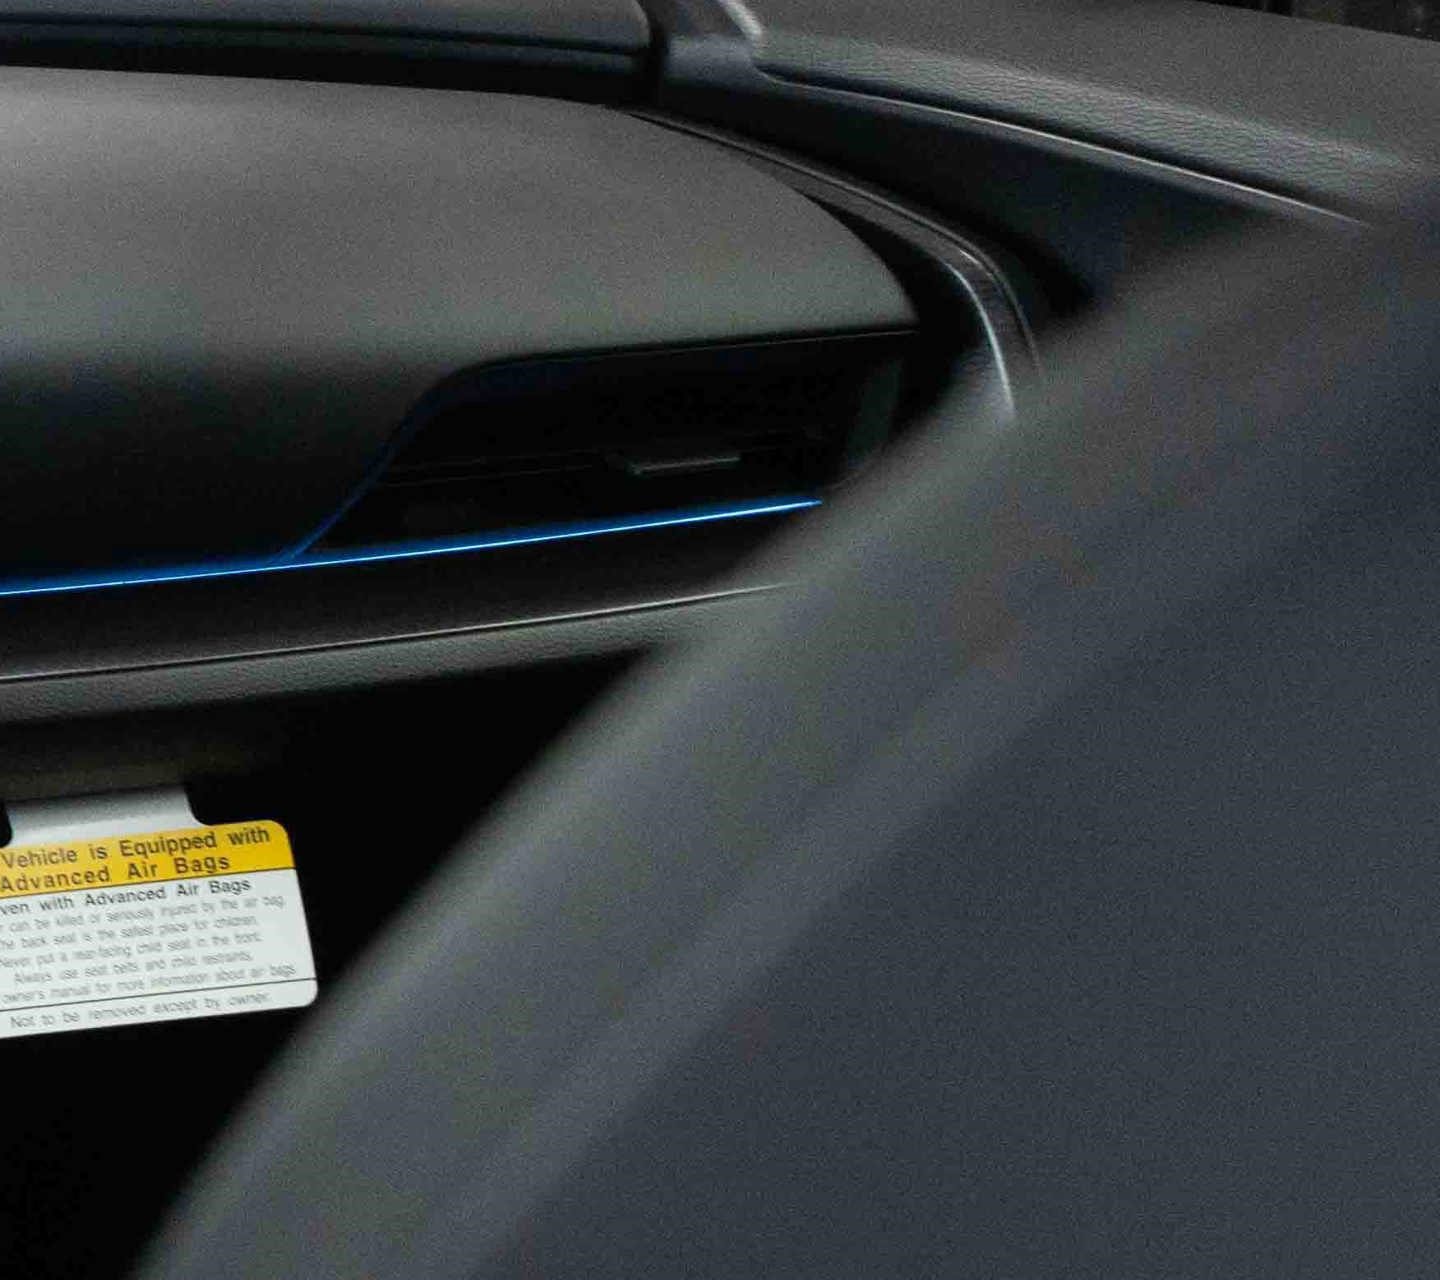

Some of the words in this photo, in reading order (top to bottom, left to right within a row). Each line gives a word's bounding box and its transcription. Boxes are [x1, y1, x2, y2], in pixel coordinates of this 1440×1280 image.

[0, 847, 79, 869] Vehicle
[89, 844, 108, 860] is
[118, 831, 218, 857] Equipped
[227, 826, 271, 846] with
[0, 865, 111, 893] Advanced
[127, 860, 159, 880] Air
[173, 855, 231, 875] Bags
[40, 894, 74, 911] with
[84, 886, 167, 907] Advanced
[177, 883, 199, 897] Air
[209, 879, 252, 896] Bags
